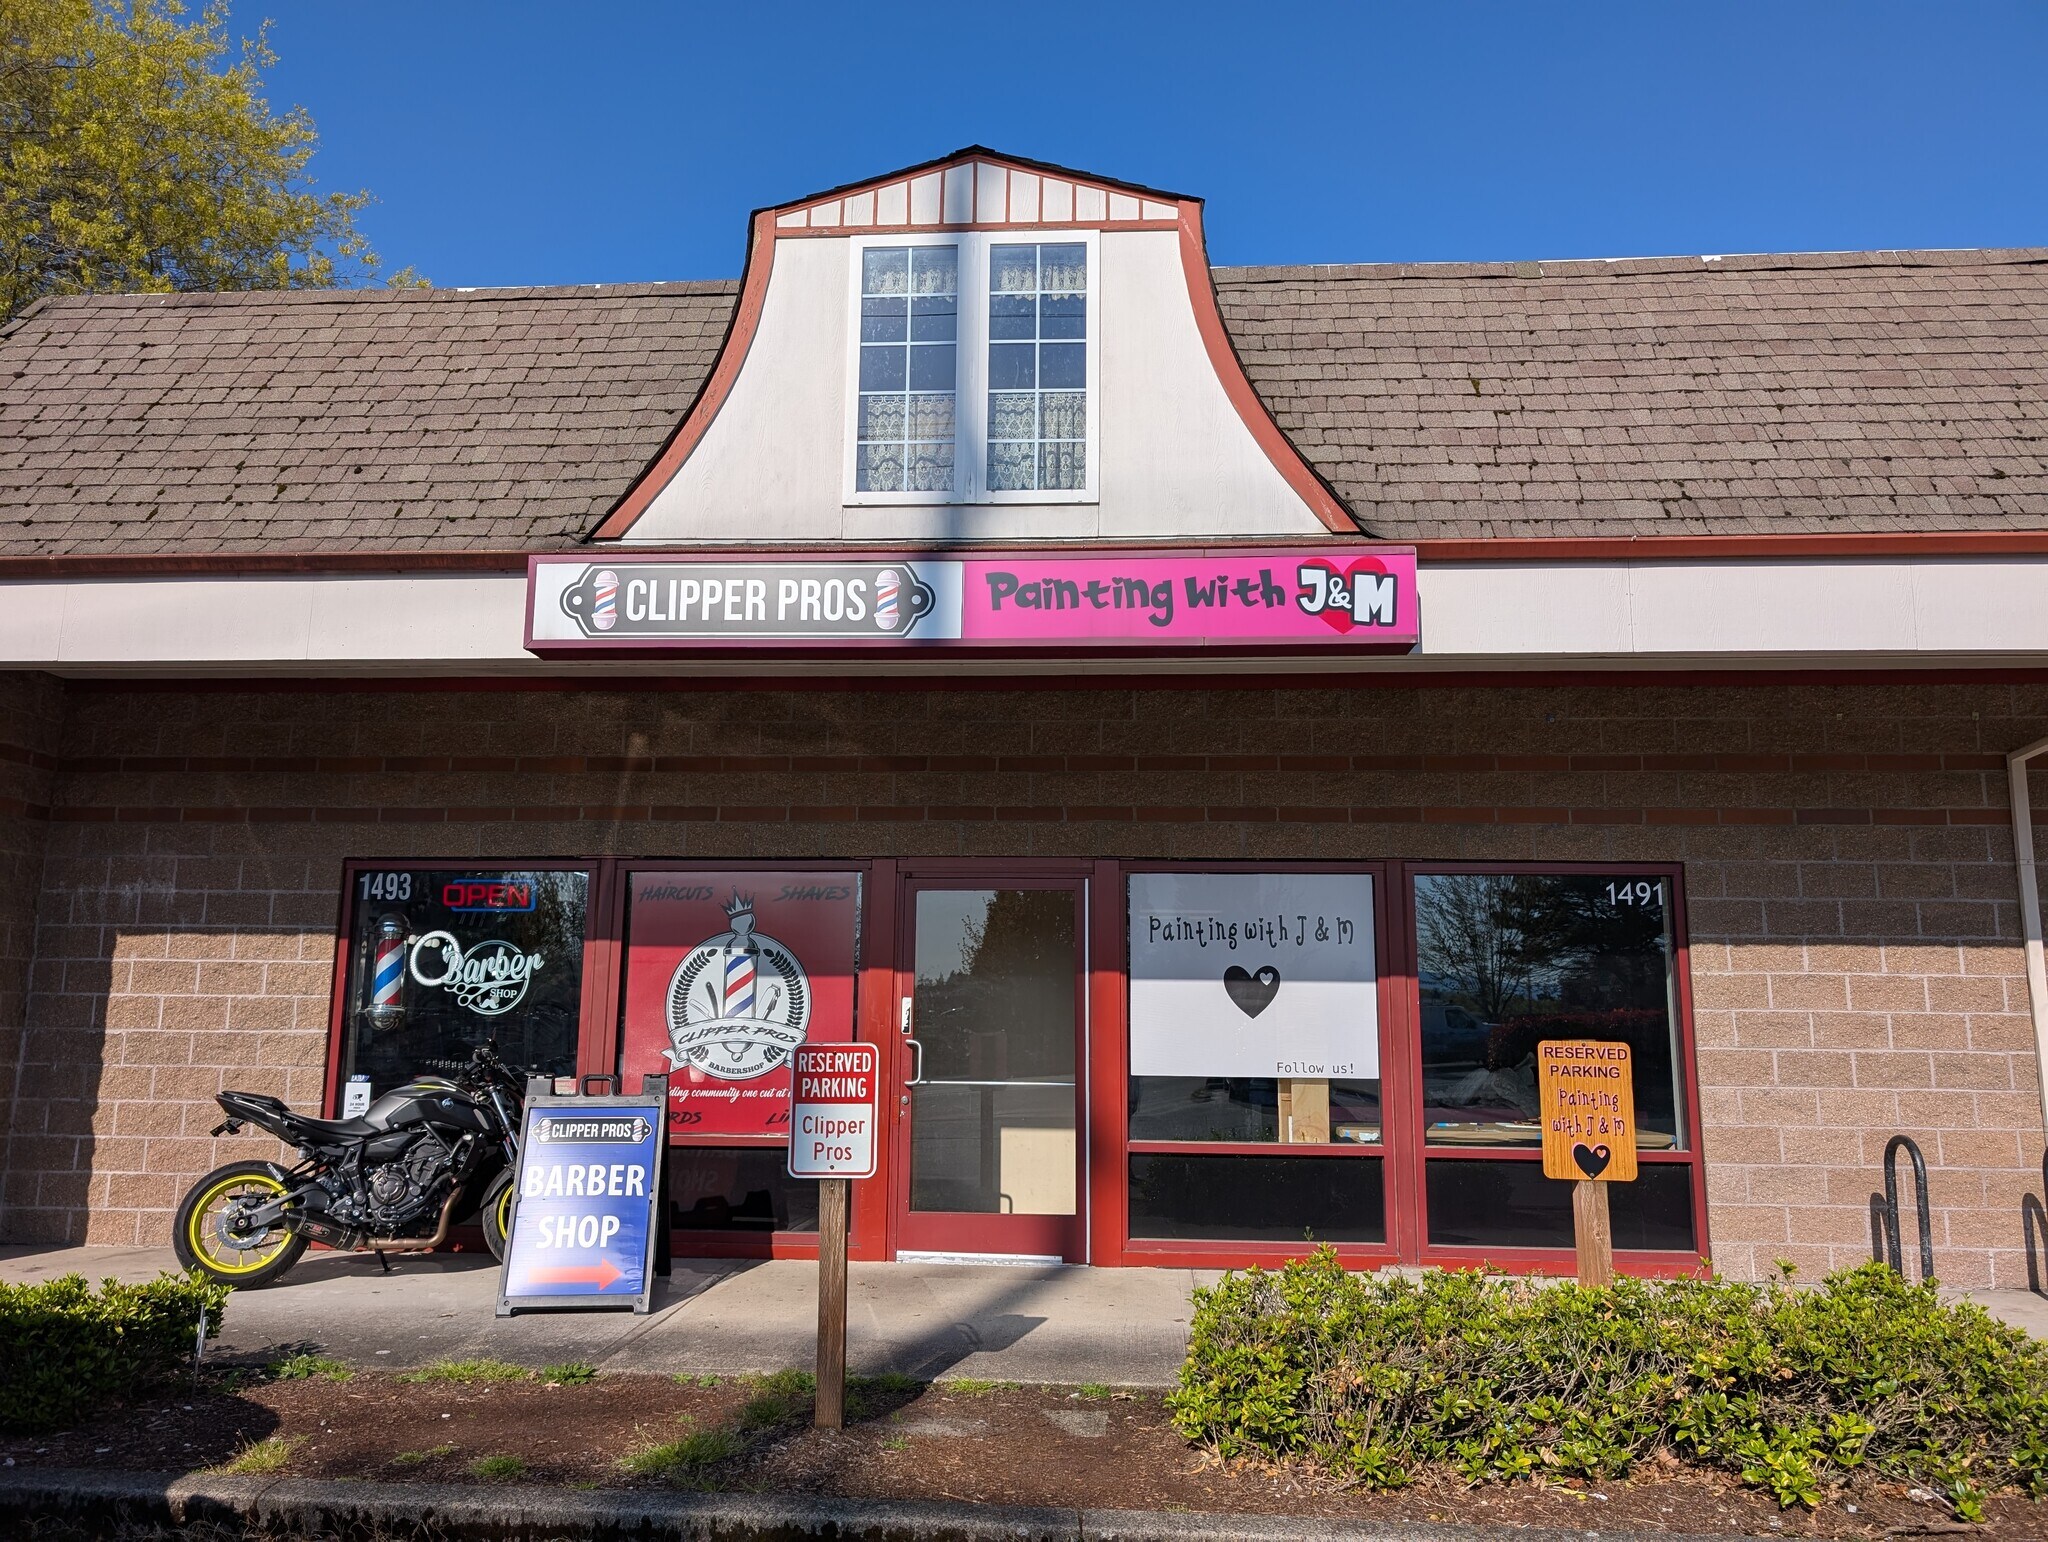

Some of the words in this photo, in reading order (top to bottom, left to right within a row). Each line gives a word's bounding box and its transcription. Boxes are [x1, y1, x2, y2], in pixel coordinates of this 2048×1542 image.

[626, 579, 767, 621] CLIPPER
[777, 578, 867, 622] PROS
[985, 571, 1173, 627] Painting
[1184, 569, 1286, 609] with
[1296, 564, 1398, 627] J&M
[359, 873, 412, 900] 1493
[443, 884, 530, 907] OPEN
[639, 880, 714, 902] HAIRCUTS
[773, 885, 850, 902] SHAVES
[1605, 882, 1664, 906] 1491
[1149, 914, 1238, 950] Painting
[1245, 916, 1289, 948] with
[1296, 915, 1307, 946] J
[1315, 916, 1329, 942] &
[1336, 917, 1354, 944] M
[441, 946, 545, 985] Barber
[489, 988, 518, 999] SHOP
[678, 1025, 751, 1045] CLIPPER
[751, 1026, 799, 1043] PROS
[798, 1053, 872, 1073] RESERVED
[1544, 1046, 1628, 1060] RESERVED
[708, 1061, 765, 1075] BARBERSHOP
[1276, 1062, 1325, 1075] Follow
[1332, 1063, 1355, 1075] us!
[1550, 1065, 1620, 1078] PARKING
[691, 1086, 741, 1103] community
[742, 1089, 759, 1098] one
[759, 1087, 776, 1098] cut
[775, 1088, 789, 1098] at
[801, 1077, 867, 1098] PARKING
[1559, 1088, 1619, 1112] Painting
[552, 1123, 599, 1138] CLIPPER
[601, 1123, 632, 1137] PROS
[802, 1115, 865, 1139] Clipper
[1552, 1115, 1582, 1137] with
[1586, 1116, 1594, 1136] J
[1599, 1117, 1609, 1134] &
[1614, 1116, 1625, 1136] M
[814, 1142, 852, 1161] Pros
[524, 1165, 646, 1197] BARBER
[535, 1215, 621, 1249] SHOP
